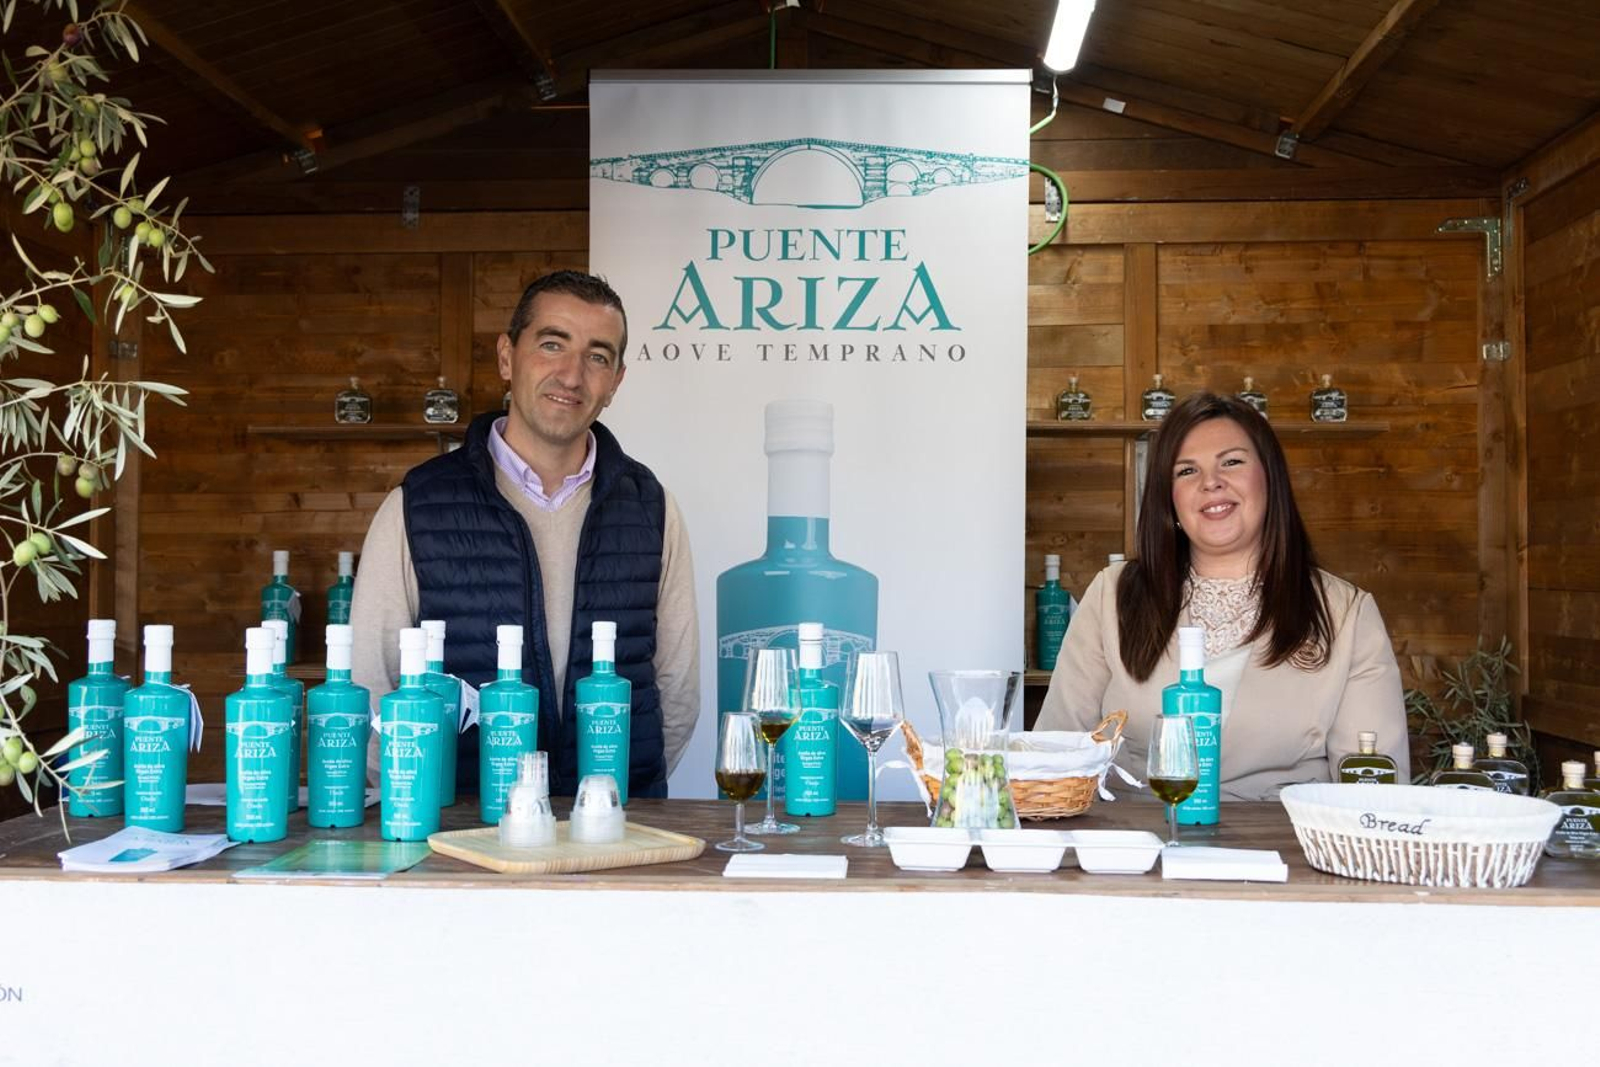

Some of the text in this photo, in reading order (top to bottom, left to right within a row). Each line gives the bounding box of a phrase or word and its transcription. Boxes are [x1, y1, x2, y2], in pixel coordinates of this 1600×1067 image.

[706, 228, 908, 262] PUENTE
[652, 260, 962, 331] ARIZA
[637, 343, 967, 362] AOVE TEMPRANO
[587, 724, 622, 734] ARIZA
[485, 736, 523, 747] ARIZA
[793, 730, 830, 741] ARIZA
[130, 740, 171, 752] ARIZA
[317, 736, 357, 748] ARIZA
[234, 746, 277, 758] ARIZA
[384, 746, 423, 758] ARIZA
[1359, 812, 1432, 835] Bread
[1561, 821, 1594, 830] ARIZA
